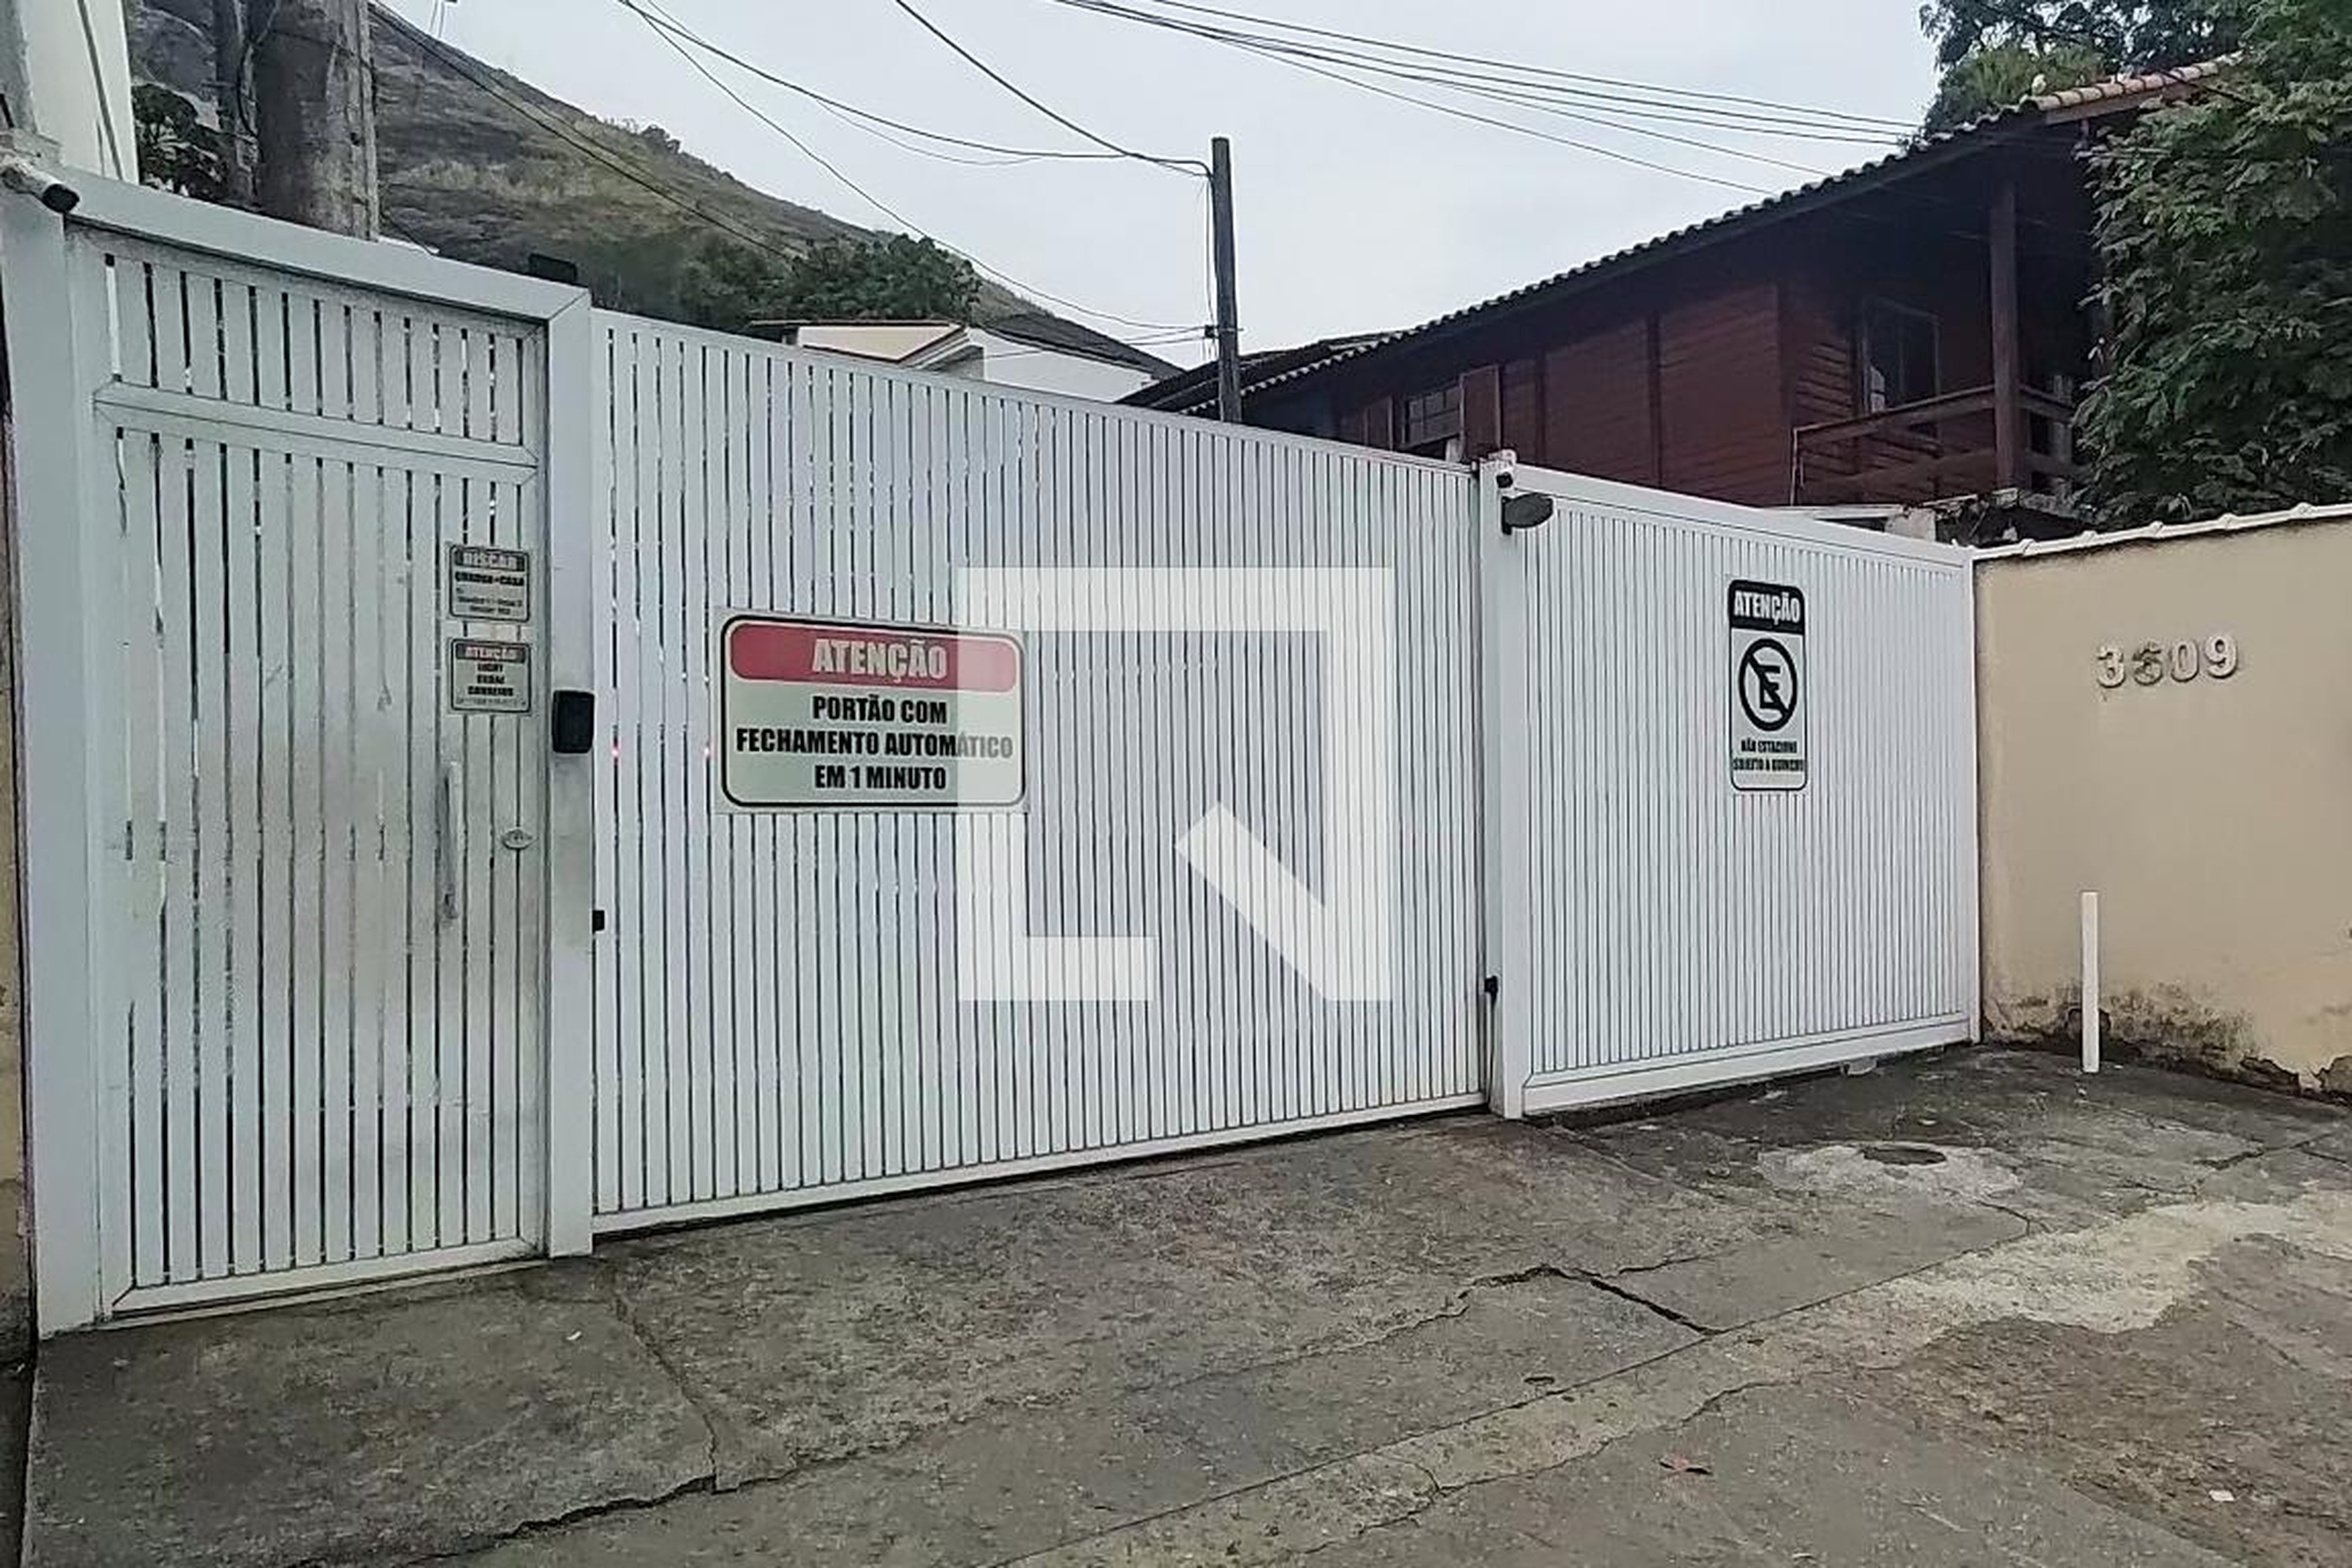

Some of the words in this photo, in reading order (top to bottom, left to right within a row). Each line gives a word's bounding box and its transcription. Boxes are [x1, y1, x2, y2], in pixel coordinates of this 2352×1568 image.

[1734, 590, 1801, 625] ATENÇÃO
[812, 639, 948, 683] ATENÇÃO
[813, 695, 894, 722] PORTÃO
[900, 702, 947, 724] COM
[736, 728, 878, 755] FECHAMENTO
[884, 732, 1013, 759] AUTOMÁTICO
[815, 765, 846, 789] EM
[850, 766, 860, 789] 1
[865, 766, 947, 790] MINUTO
